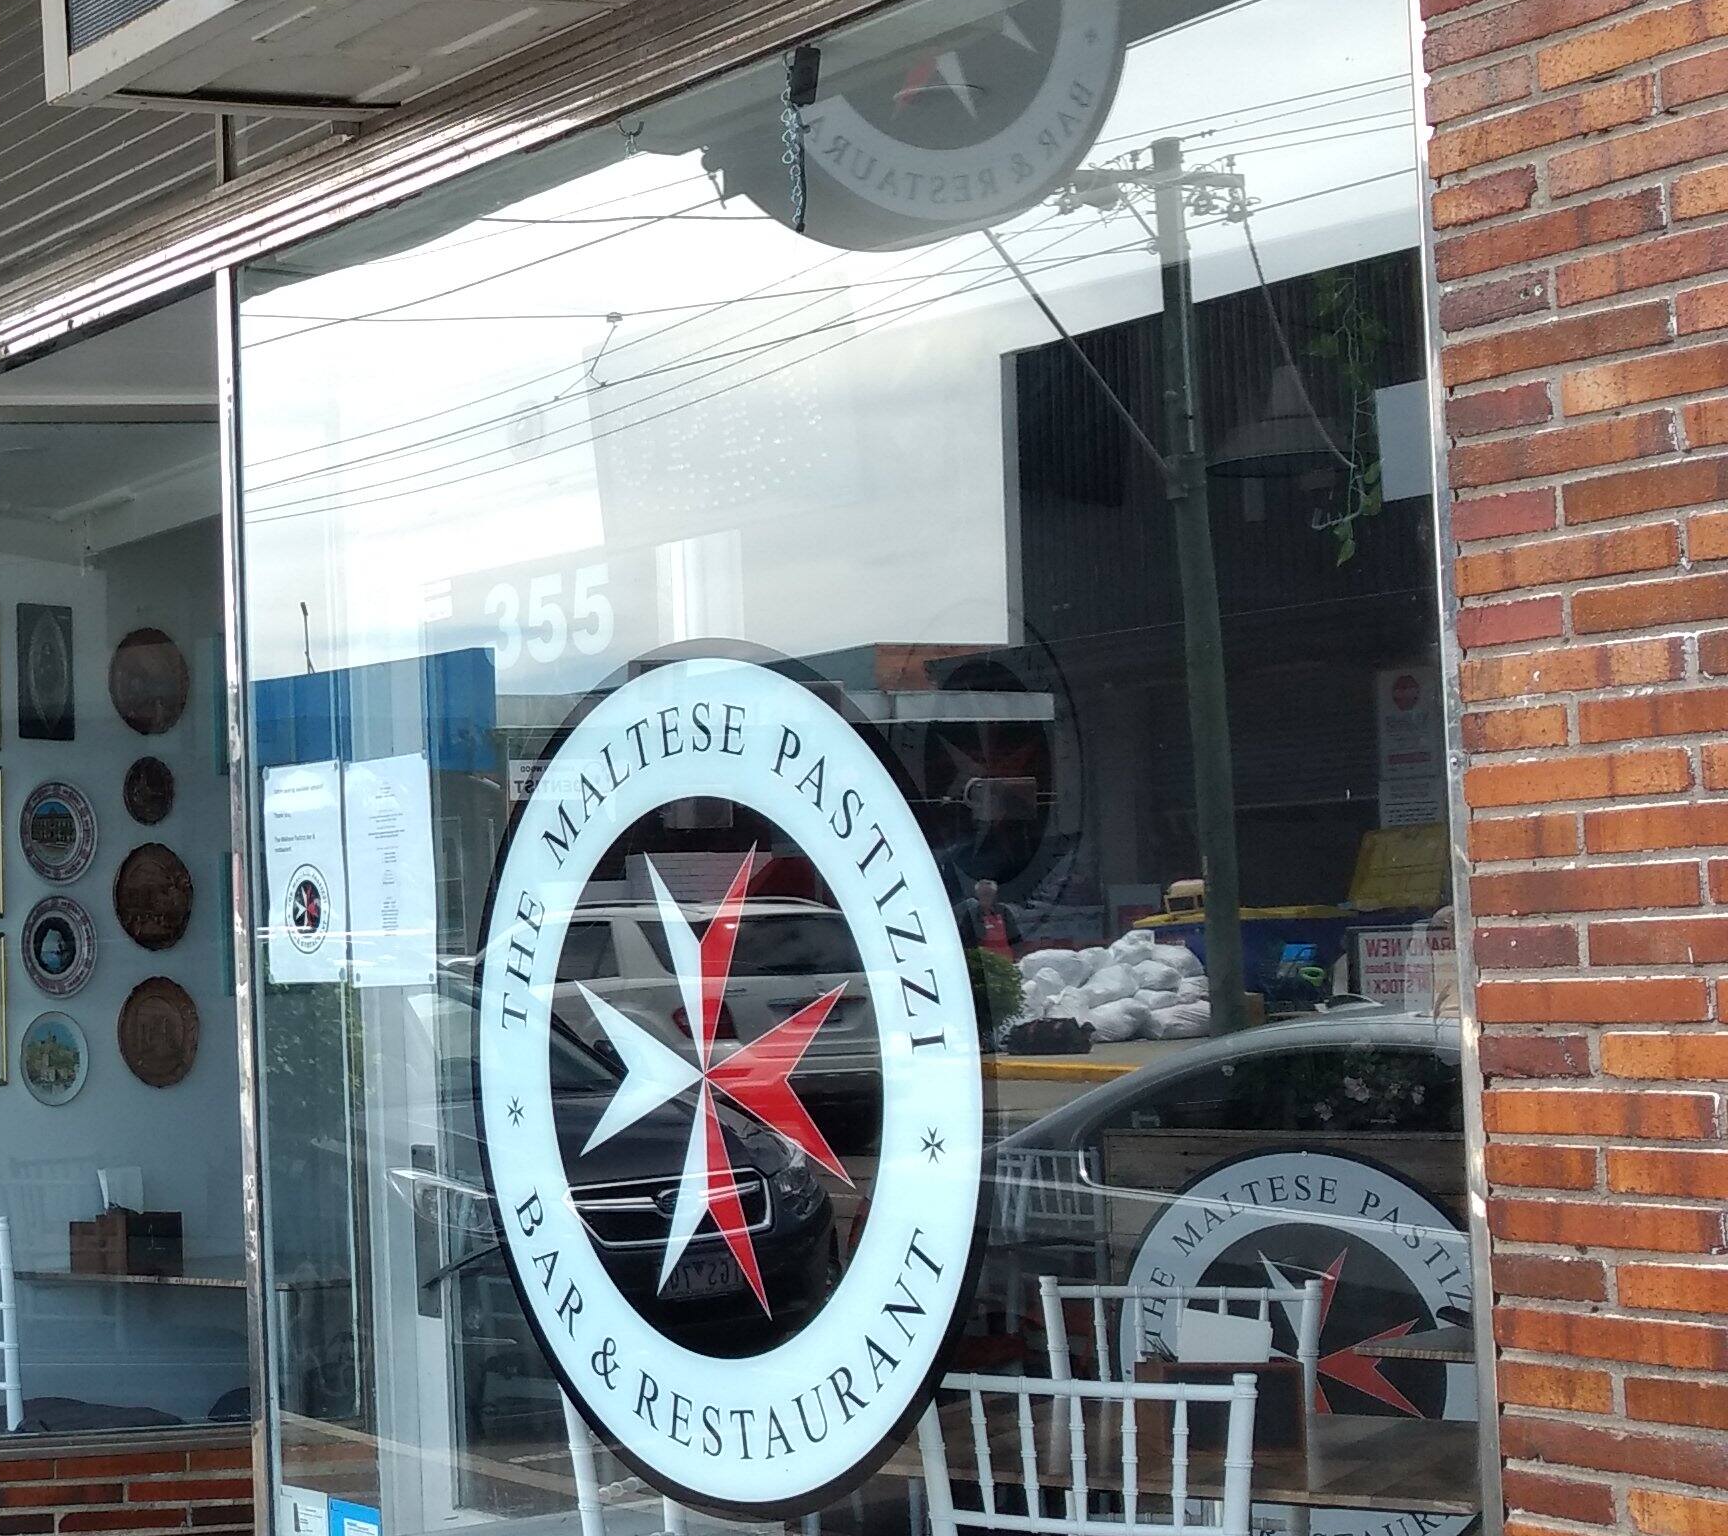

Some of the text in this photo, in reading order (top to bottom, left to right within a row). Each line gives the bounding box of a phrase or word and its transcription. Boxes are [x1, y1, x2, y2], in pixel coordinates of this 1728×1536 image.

[483, 562, 615, 671] 355
[500, 889, 547, 1031] THE
[542, 703, 747, 871] MALTESE
[772, 723, 948, 1056] PASTIZZI
[1172, 1174, 1338, 1258] MALTESE
[514, 1185, 946, 1461] BAR & RESTAURANT
